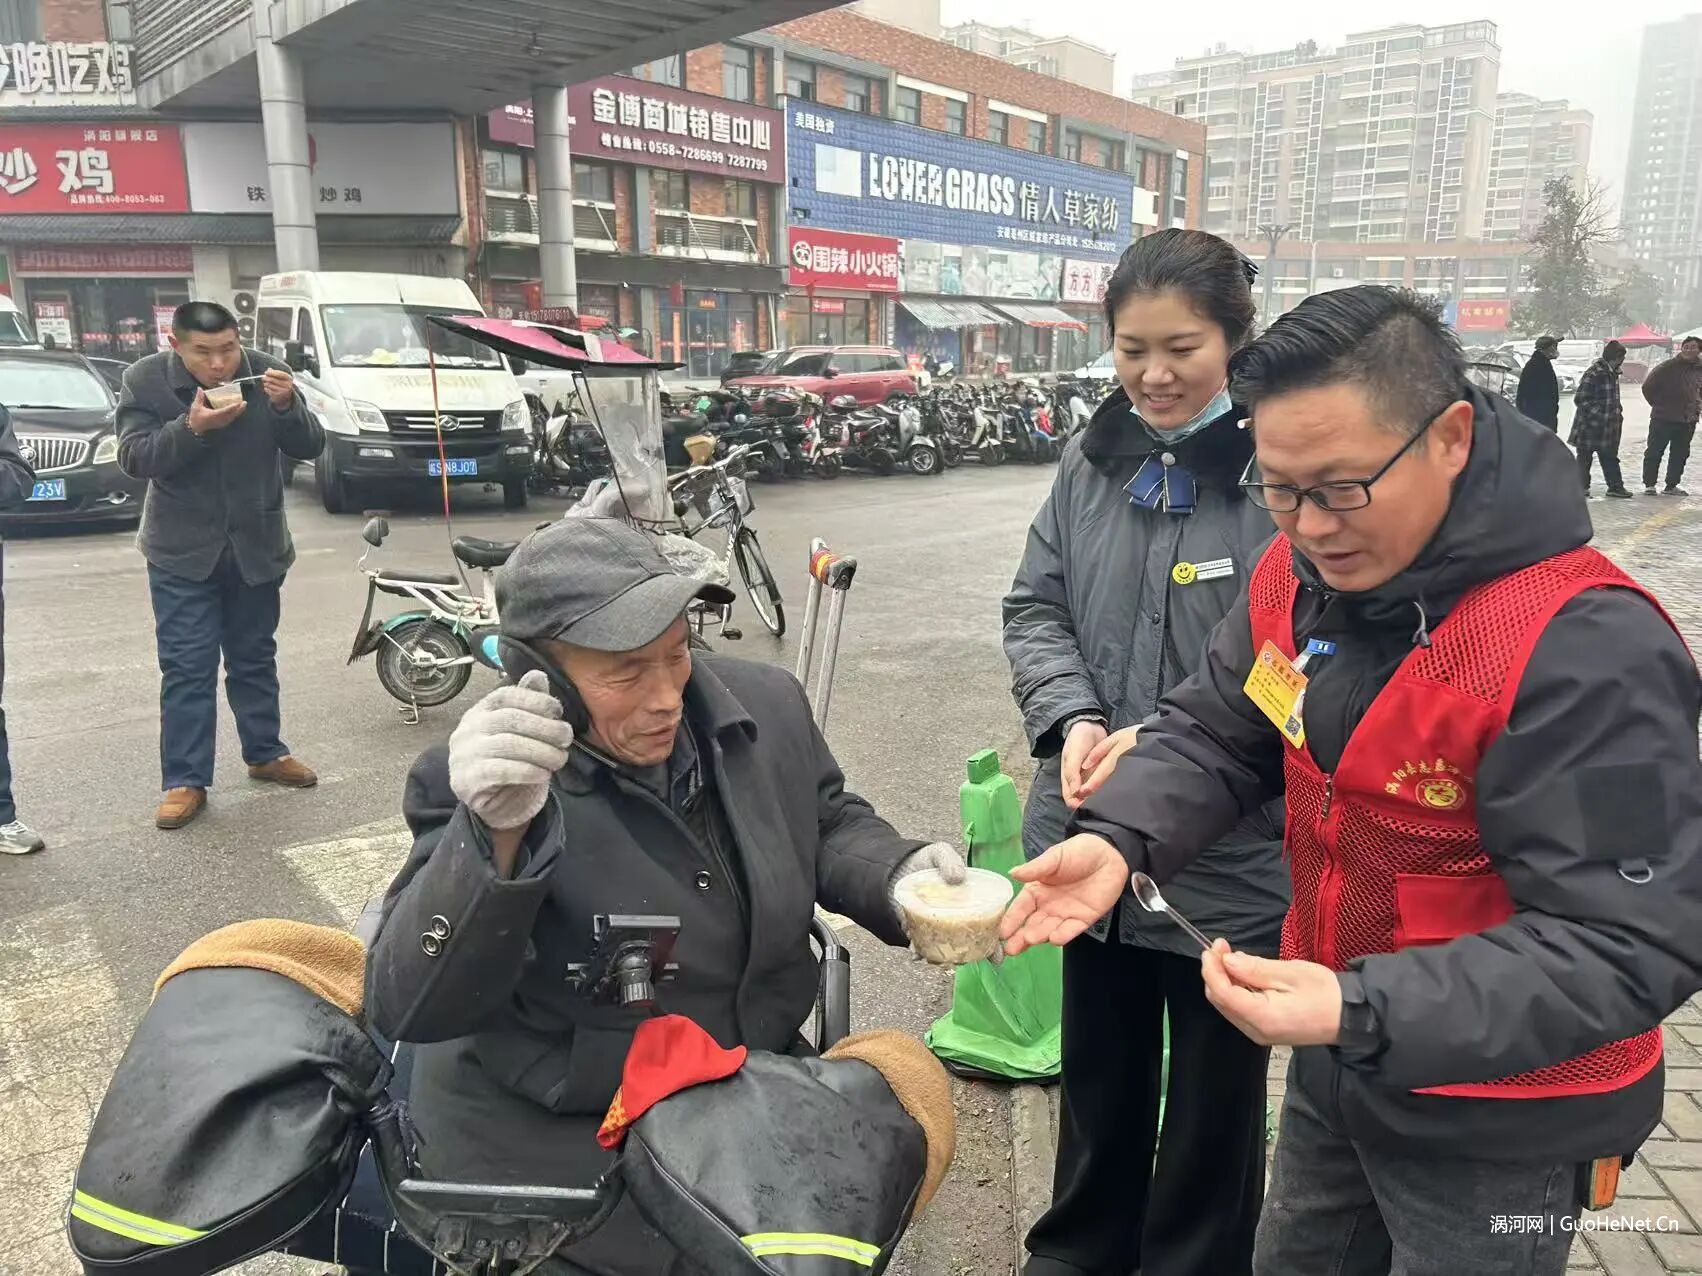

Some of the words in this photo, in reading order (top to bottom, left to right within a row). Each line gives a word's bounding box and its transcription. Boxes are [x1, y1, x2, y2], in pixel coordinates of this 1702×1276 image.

[592, 87, 771, 151] 金博商城销售中心
[727, 152, 768, 172] 7287799
[869, 152, 943, 207] LOVER
[945, 167, 1015, 216] GRASS
